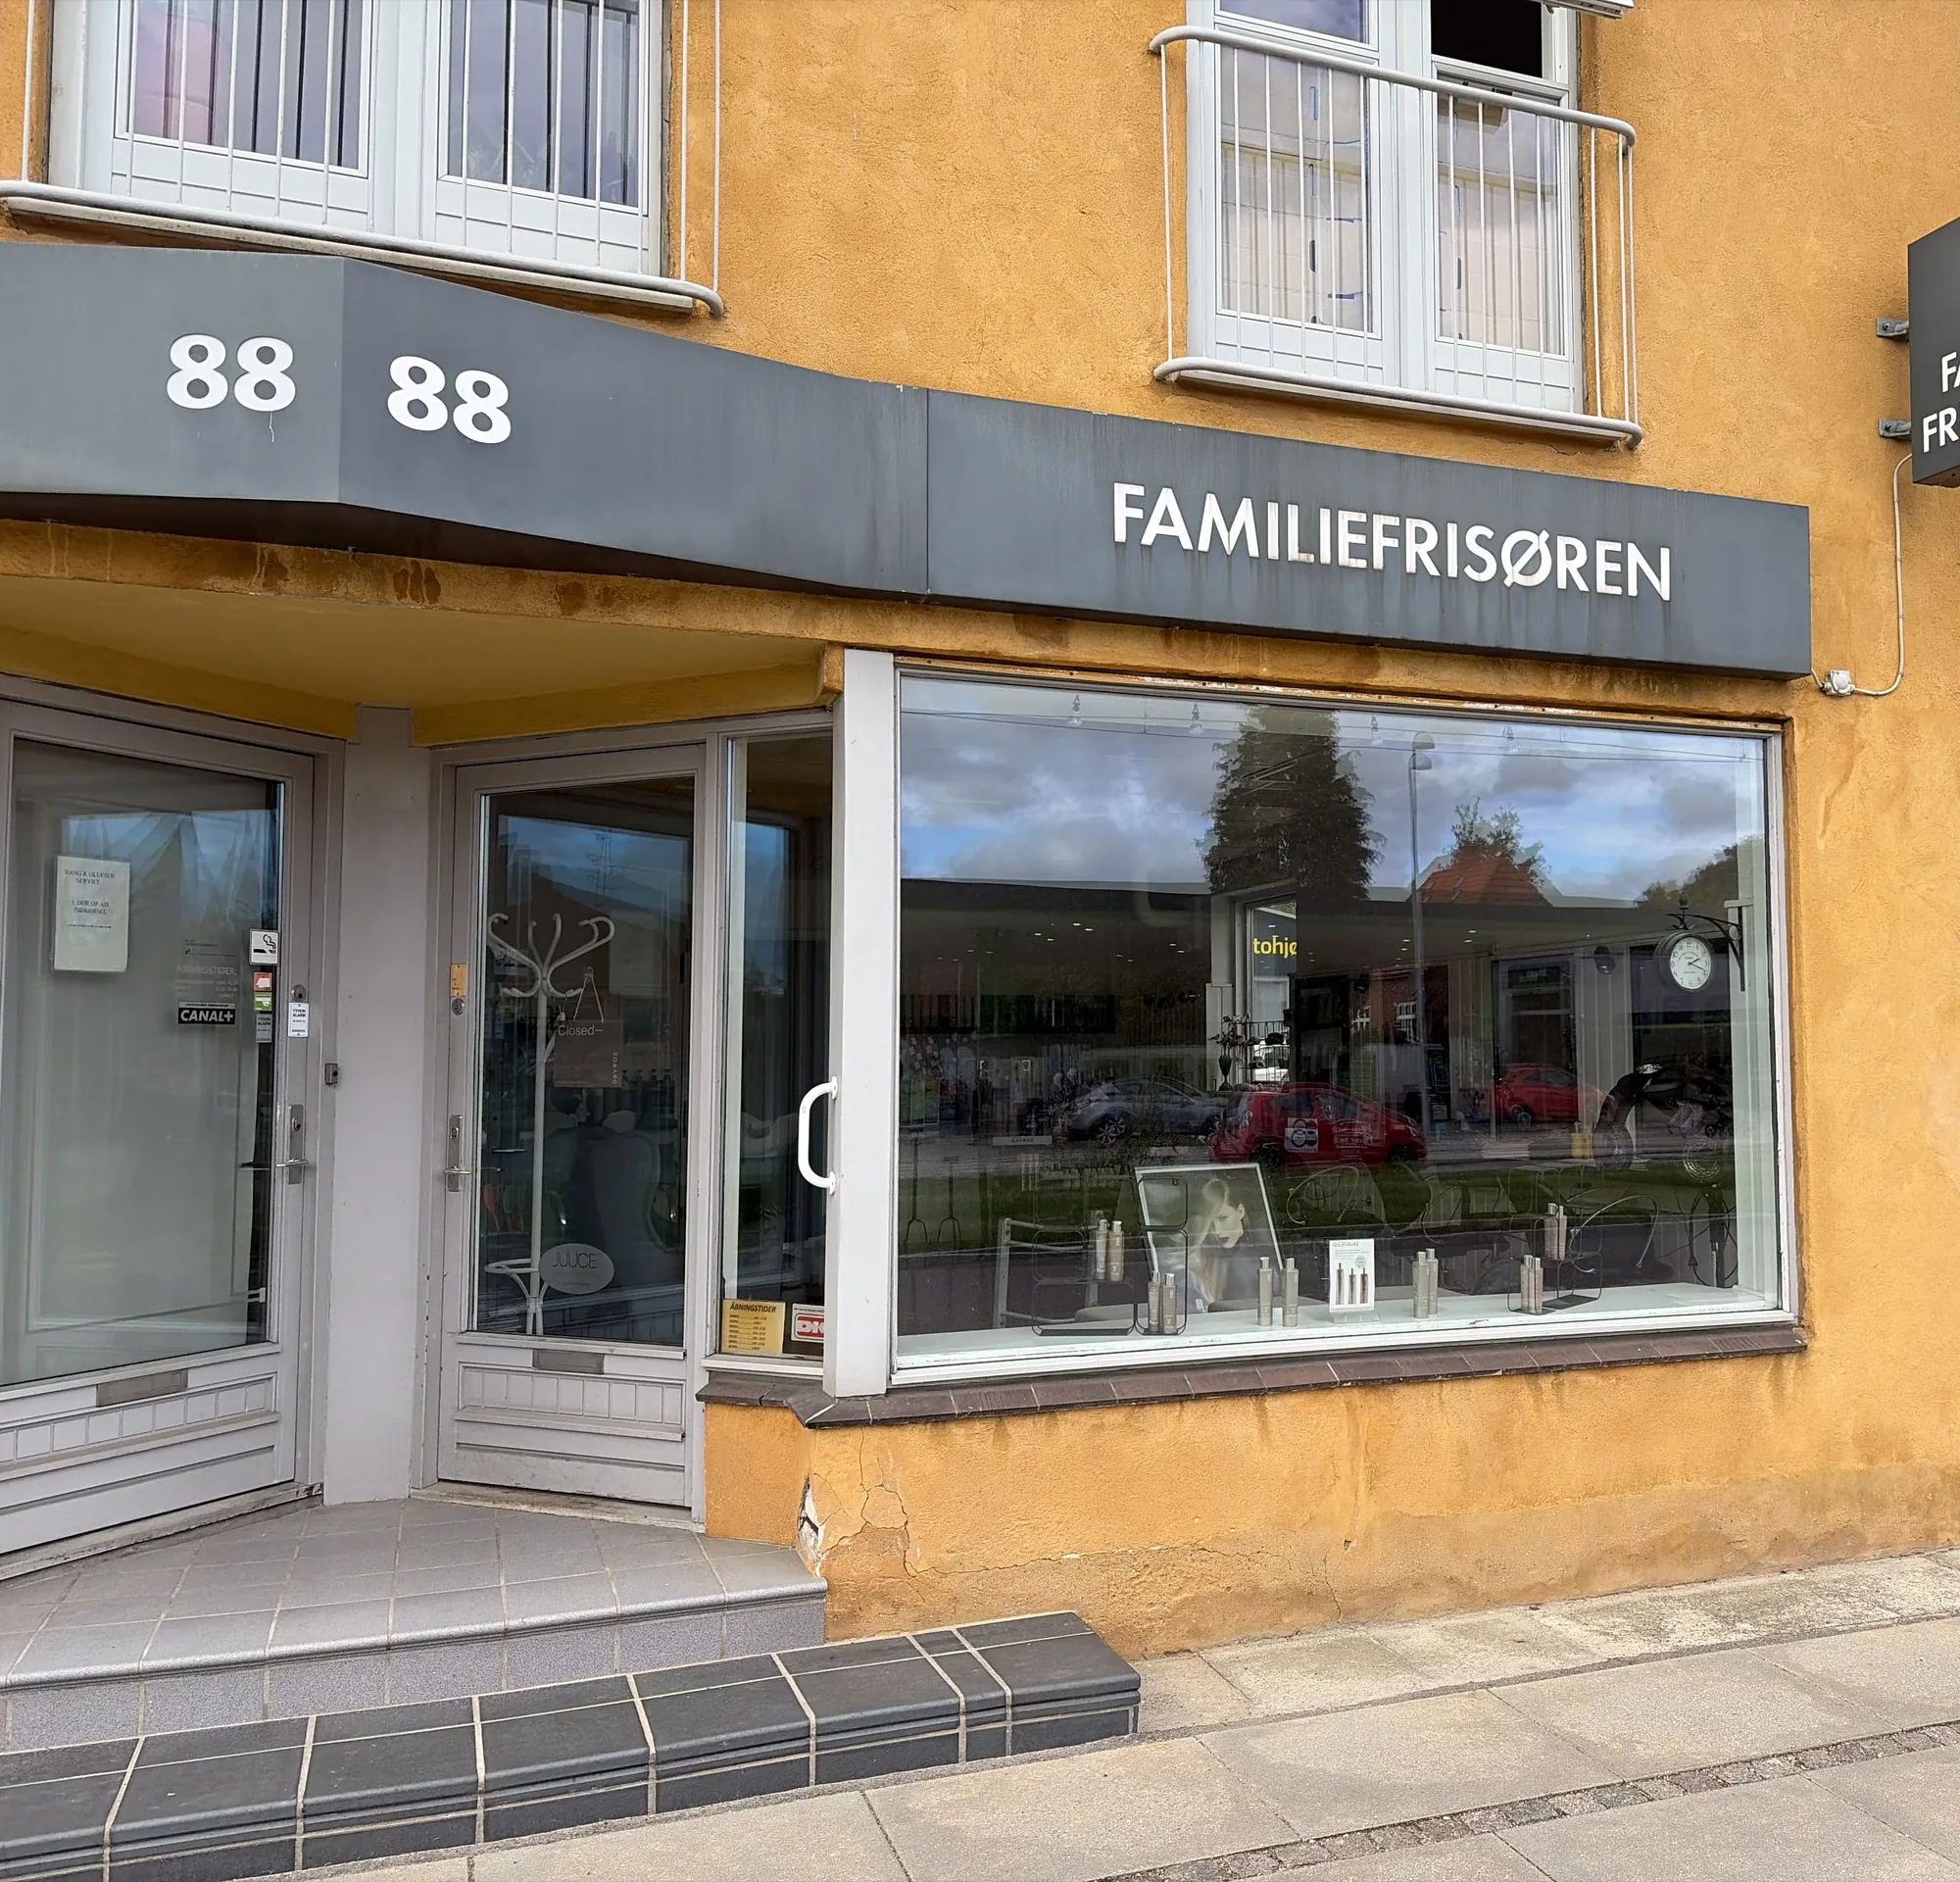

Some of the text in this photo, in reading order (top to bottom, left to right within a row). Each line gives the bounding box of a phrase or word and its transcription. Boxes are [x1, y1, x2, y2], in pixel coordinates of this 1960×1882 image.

[167, 333, 296, 412] 88
[1941, 351, 1960, 393] F
[387, 355, 512, 444] 88
[1113, 481, 1671, 602] FAMILIEFRISØREN
[180, 1010, 234, 1022] CANAL+
[553, 1253, 598, 1269] JUUCE
[729, 1301, 777, 1313] ÅBNINGSTIDER
